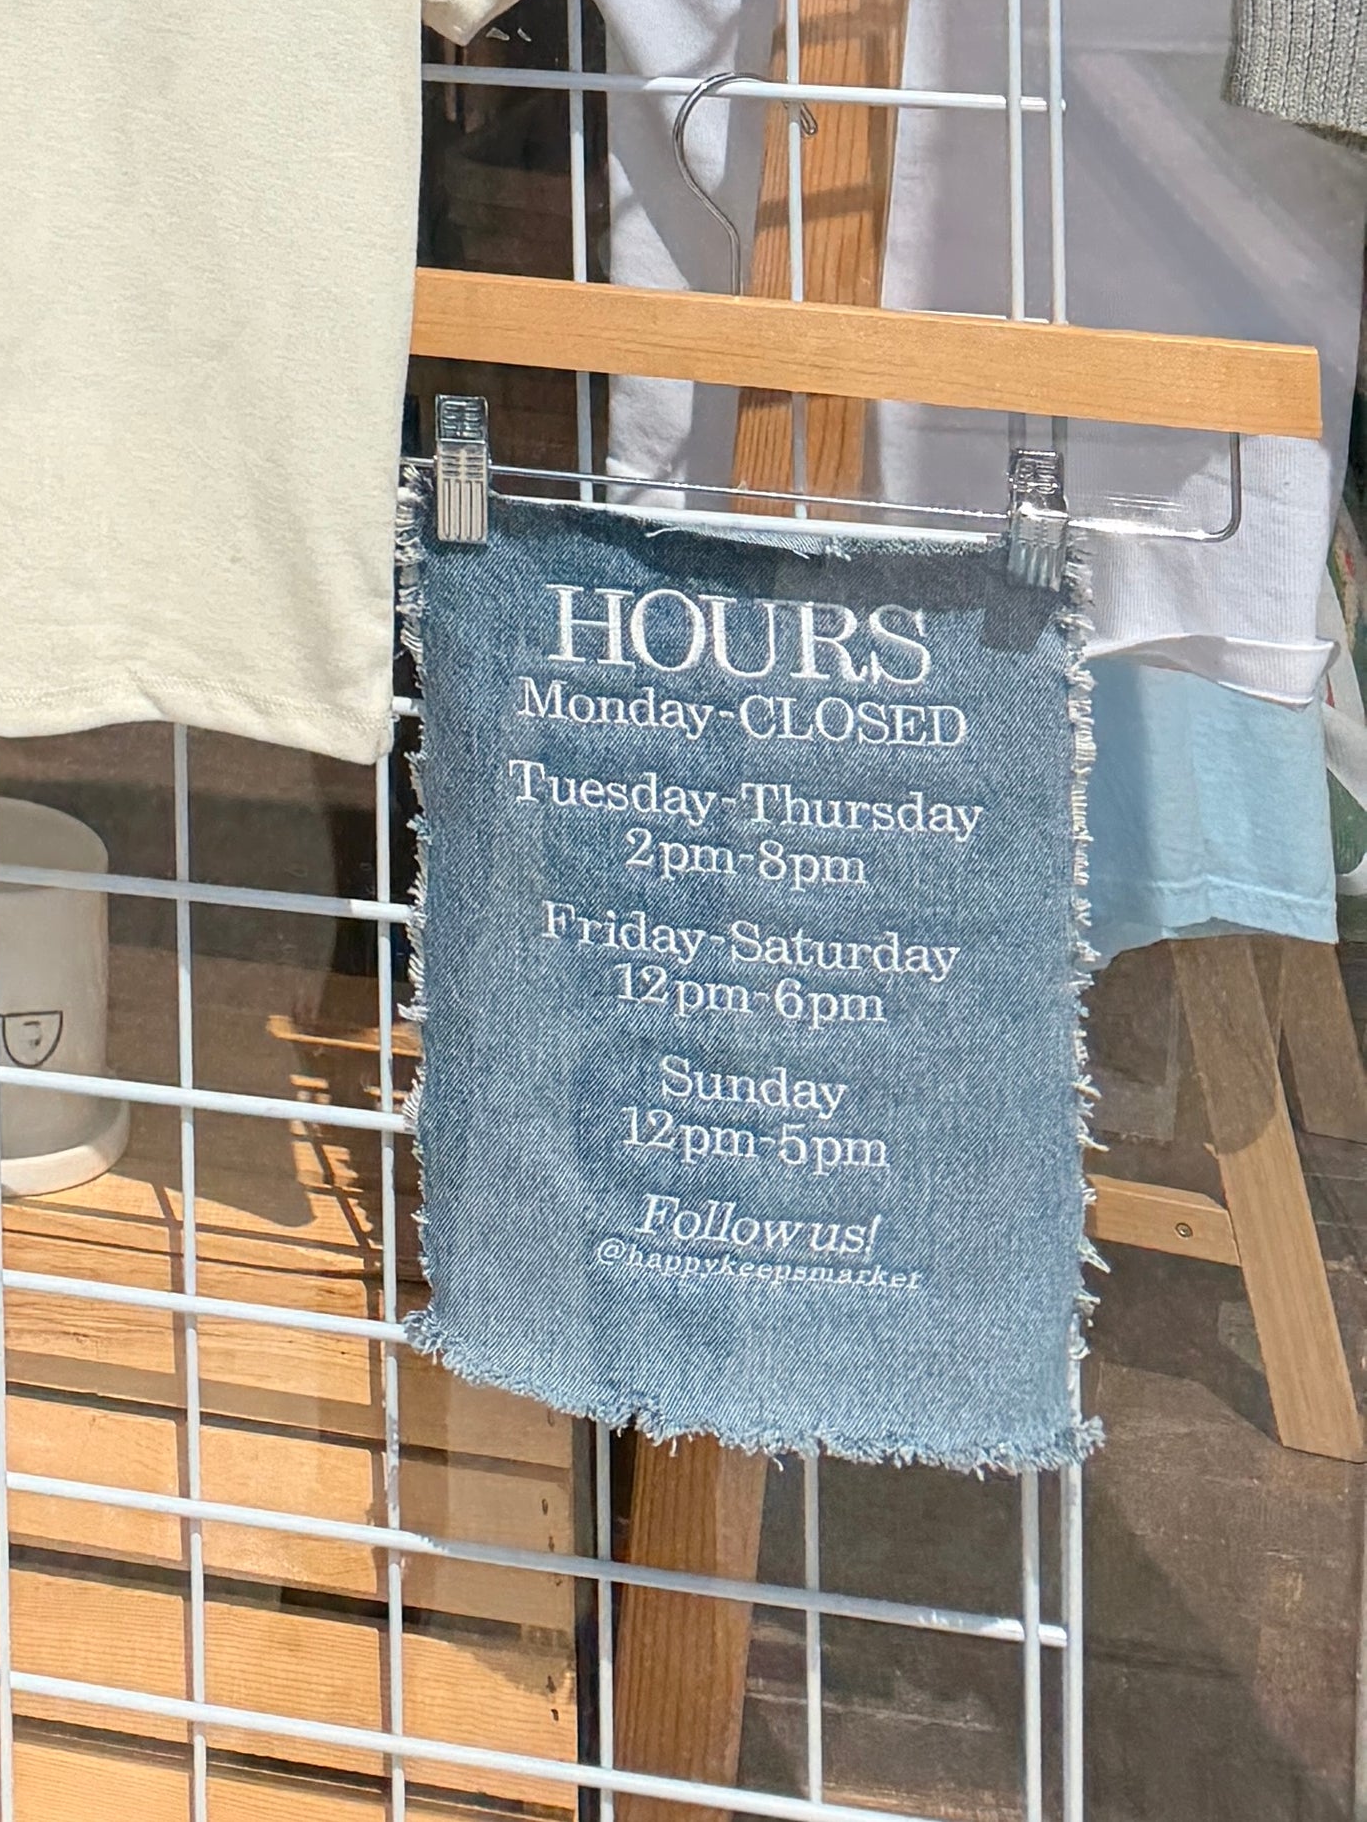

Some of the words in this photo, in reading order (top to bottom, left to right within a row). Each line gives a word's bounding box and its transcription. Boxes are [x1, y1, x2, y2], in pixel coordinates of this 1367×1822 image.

[545, 582, 932, 685] HOURS
[516, 675, 968, 748] Monday-CLOSED
[507, 758, 985, 844] Tuesday-Thursday
[624, 826, 868, 892] 2pm-8pm
[540, 899, 962, 983] Friday-Saturday
[613, 961, 888, 1031] 12pm-6pm
[660, 1054, 848, 1120] Sunday
[620, 1105, 890, 1177] 12pm-5pm
[596, 1236, 924, 1290] @happykeepsmarket
